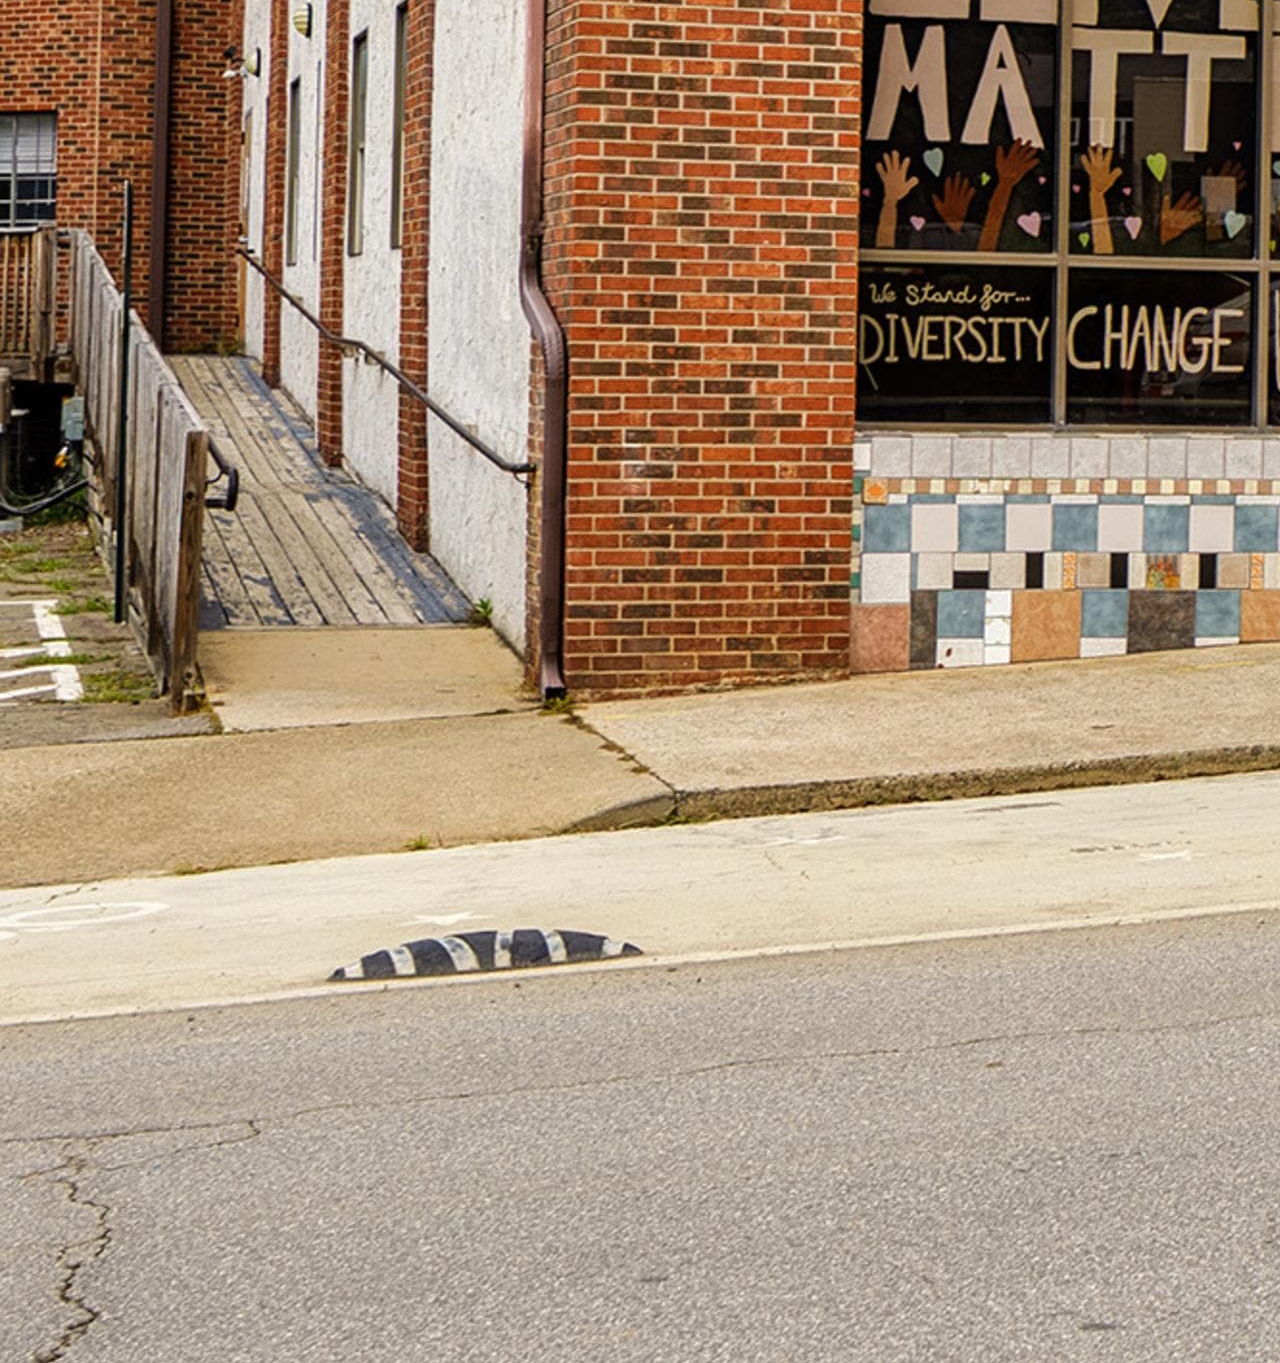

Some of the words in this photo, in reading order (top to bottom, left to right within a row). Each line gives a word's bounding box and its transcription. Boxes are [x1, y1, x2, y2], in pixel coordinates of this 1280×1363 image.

[869, 282, 897, 303] We
[905, 282, 977, 306] Stand
[858, 313, 1049, 364] DIVERSITY
[1068, 304, 1245, 374] CHANGE
